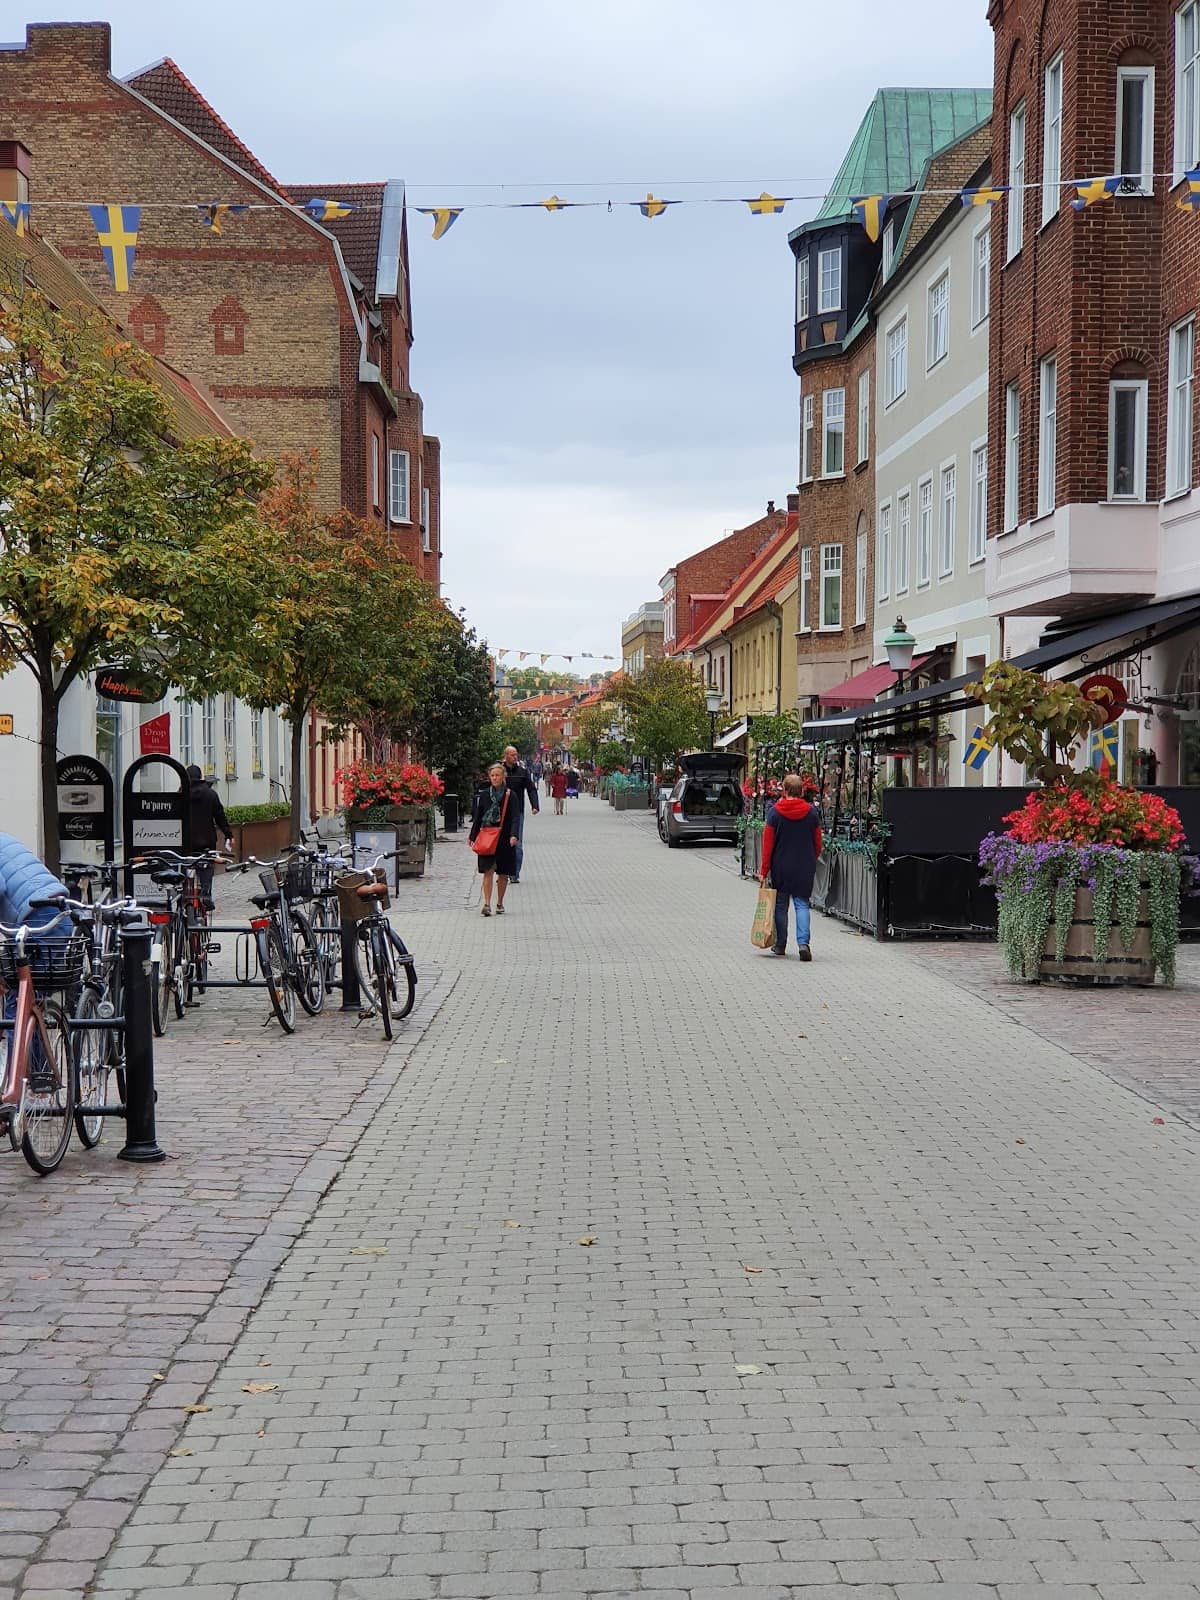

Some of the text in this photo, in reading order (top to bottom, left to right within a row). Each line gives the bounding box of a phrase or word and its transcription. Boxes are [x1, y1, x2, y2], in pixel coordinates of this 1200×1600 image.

[101, 676, 129, 695] Happy
[144, 728, 166, 737] Drop
[151, 736, 160, 744] in
